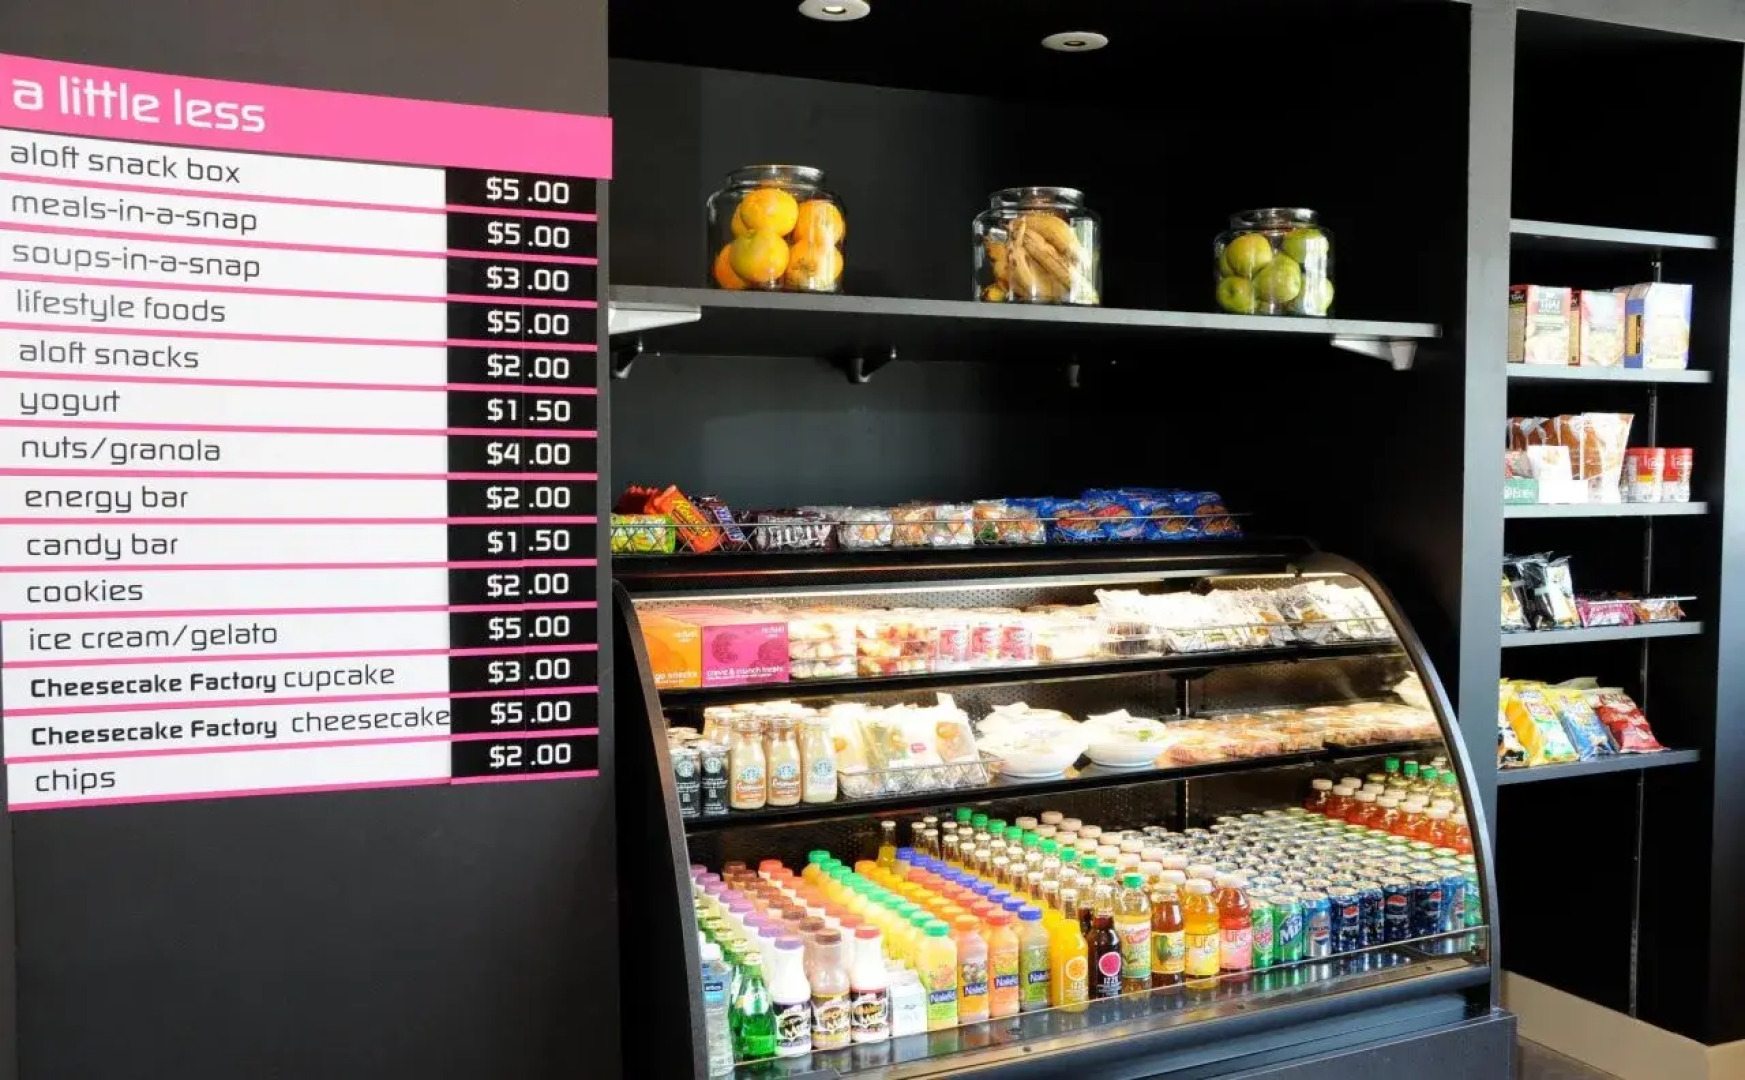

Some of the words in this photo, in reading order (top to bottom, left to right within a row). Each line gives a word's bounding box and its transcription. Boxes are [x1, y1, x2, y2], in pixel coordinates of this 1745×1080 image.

[12, 79, 44, 110] a
[58, 75, 160, 124] little
[174, 88, 265, 133] less
[10, 142, 80, 169] aloft
[88, 153, 177, 178] snack
[187, 157, 240, 184] box
[12, 195, 257, 232] meals-in-a-snap
[13, 244, 260, 282] soups-in-a-snap
[17, 289, 134, 323] lifestyle
[144, 296, 226, 323] foods
[19, 339, 87, 364] aloft
[94, 345, 199, 369] snacks
[20, 390, 121, 417] yogurt
[21, 435, 220, 466] nuts/granola
[25, 490, 132, 514] energy
[141, 485, 188, 508] bar
[26, 533, 121, 561] candy
[131, 533, 178, 555] bar
[26, 579, 143, 604] cookies
[29, 627, 72, 651] ice
[81, 622, 278, 652] cream/gelato
[30, 674, 183, 698] Cheesecake
[190, 671, 277, 694] Factory
[284, 663, 395, 692] cupcake
[31, 721, 183, 746] Cheesecake
[190, 717, 278, 739] Factory
[292, 706, 450, 733] cheesecake
[35, 767, 116, 796] chips
